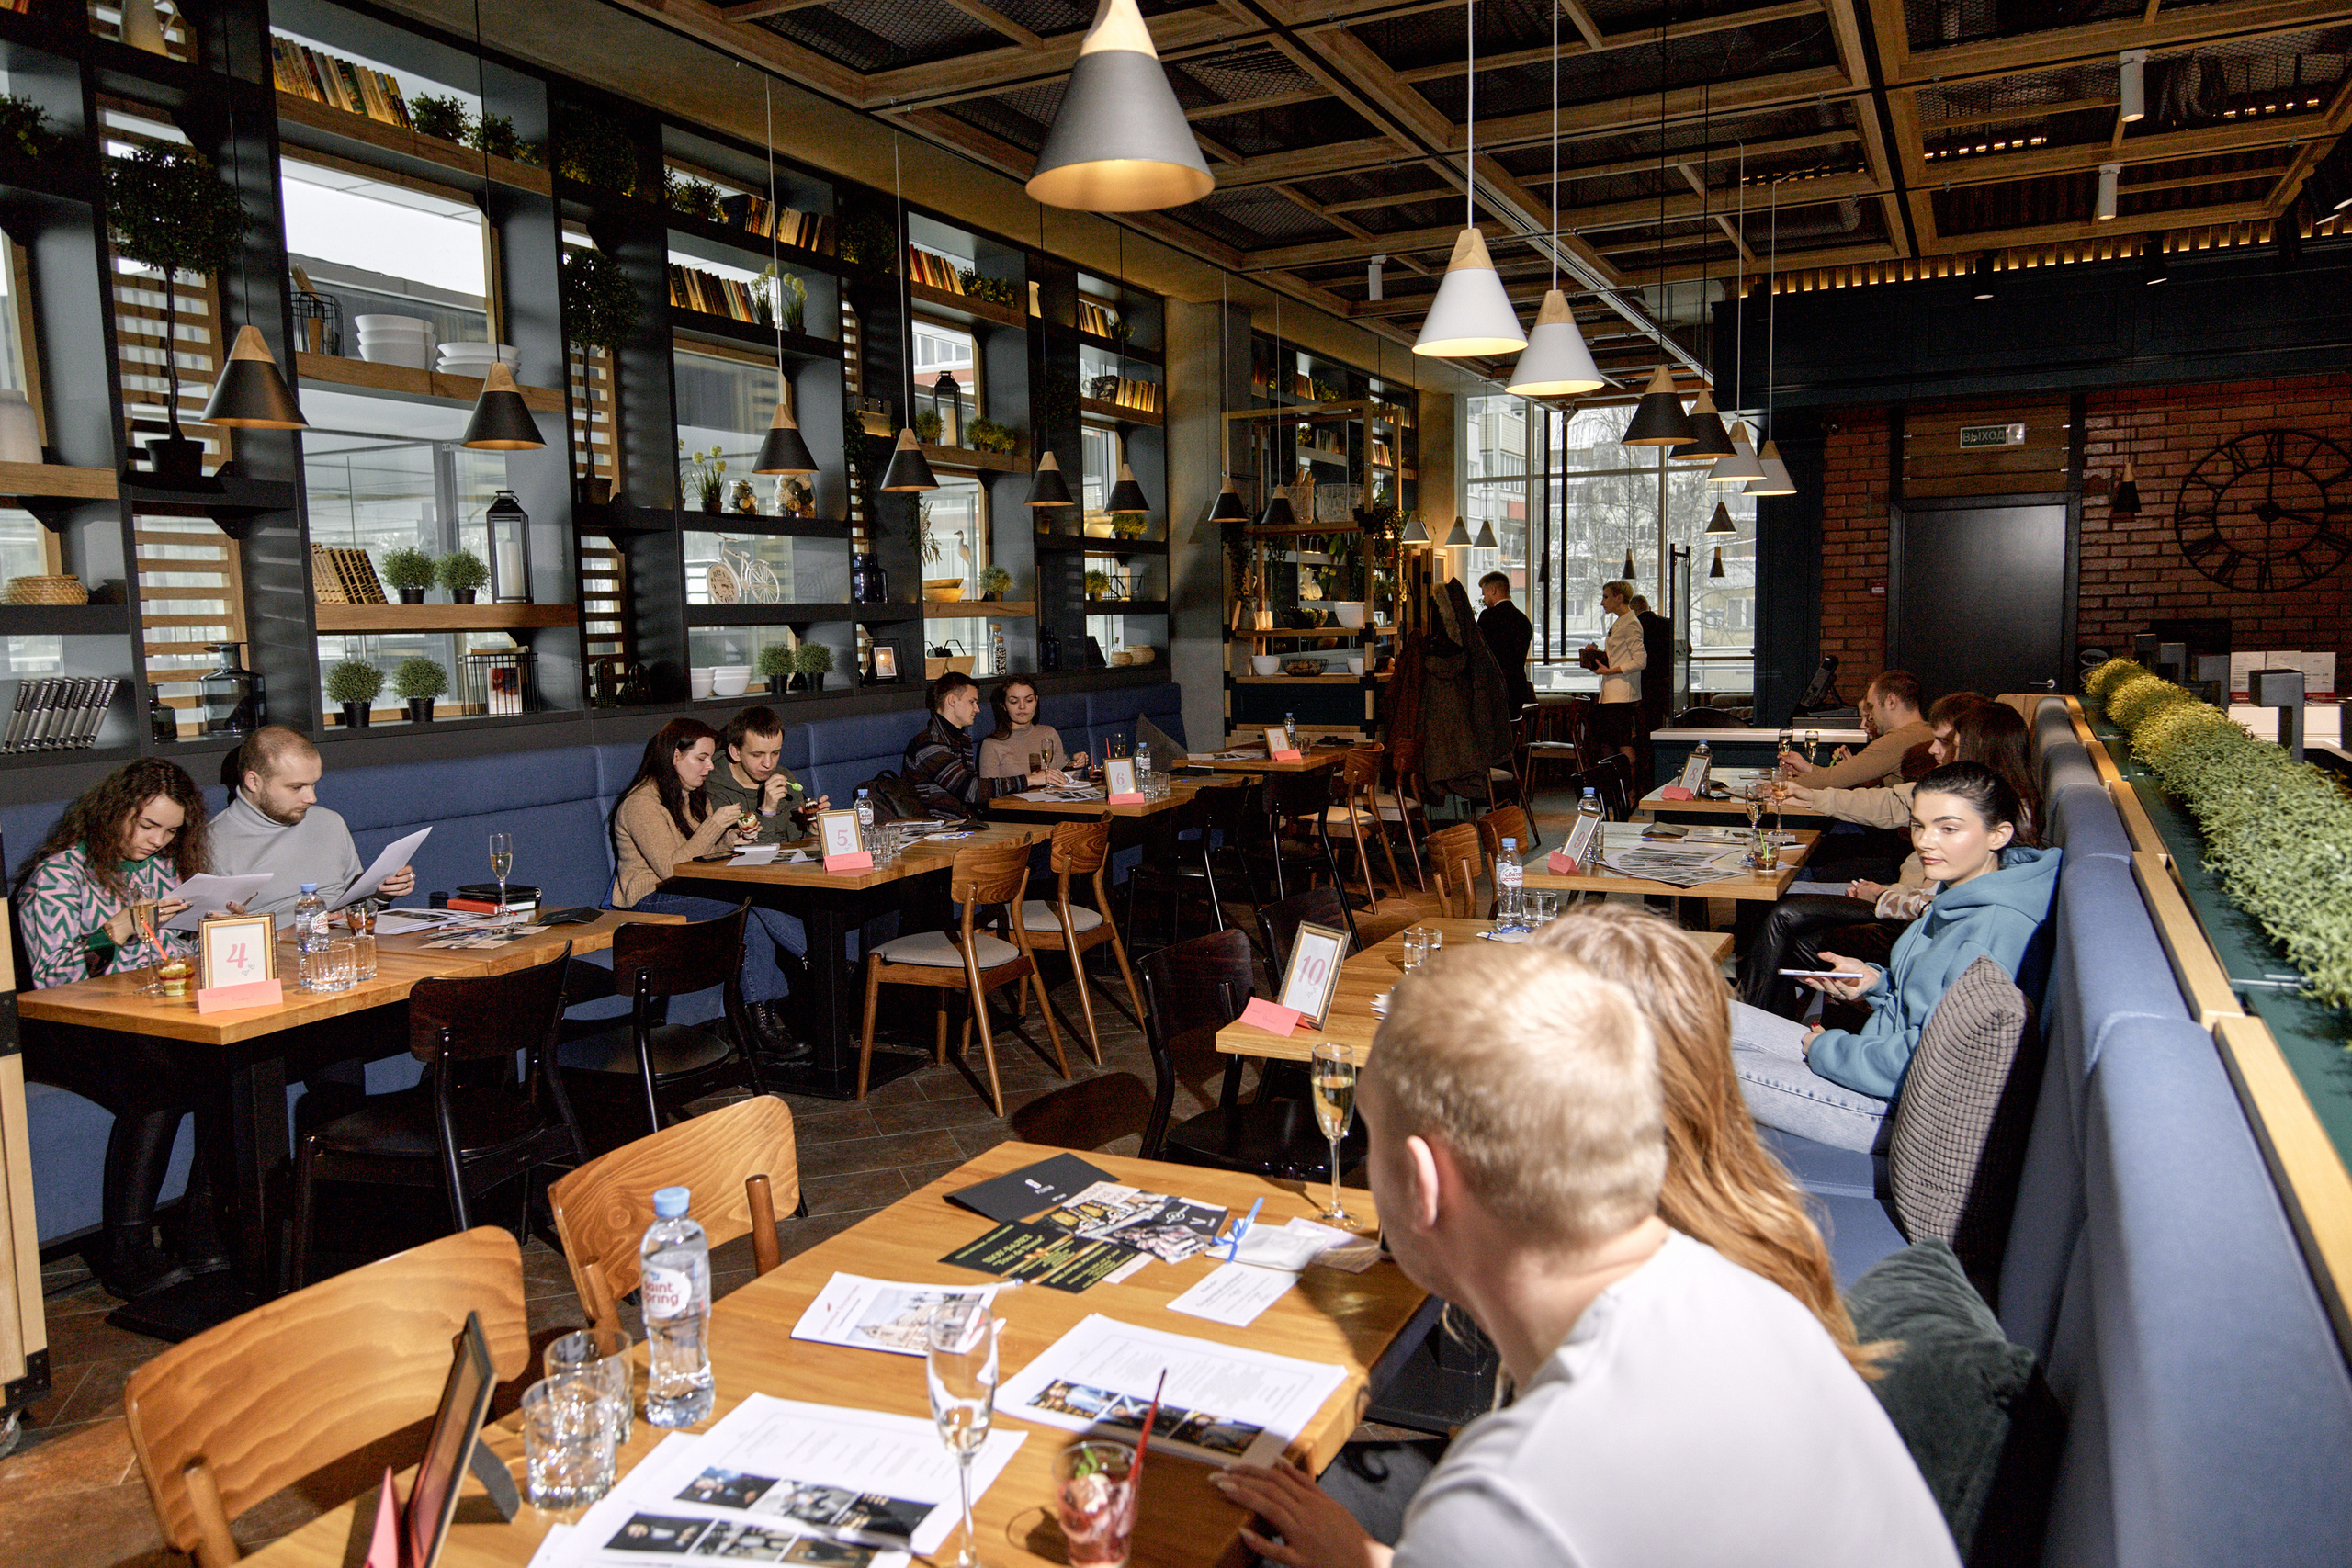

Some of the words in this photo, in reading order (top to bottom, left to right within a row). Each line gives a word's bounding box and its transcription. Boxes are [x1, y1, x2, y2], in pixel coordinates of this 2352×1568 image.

[1962, 430, 2006, 443] ВЫХОД
[1274, 736, 1281, 746] 7
[1116, 772, 1125, 785] 6
[1689, 767, 1699, 781] 8
[837, 829, 849, 847] 5
[1574, 831, 1586, 849] 9
[226, 942, 249, 969] 4
[1297, 955, 1327, 987] 10
